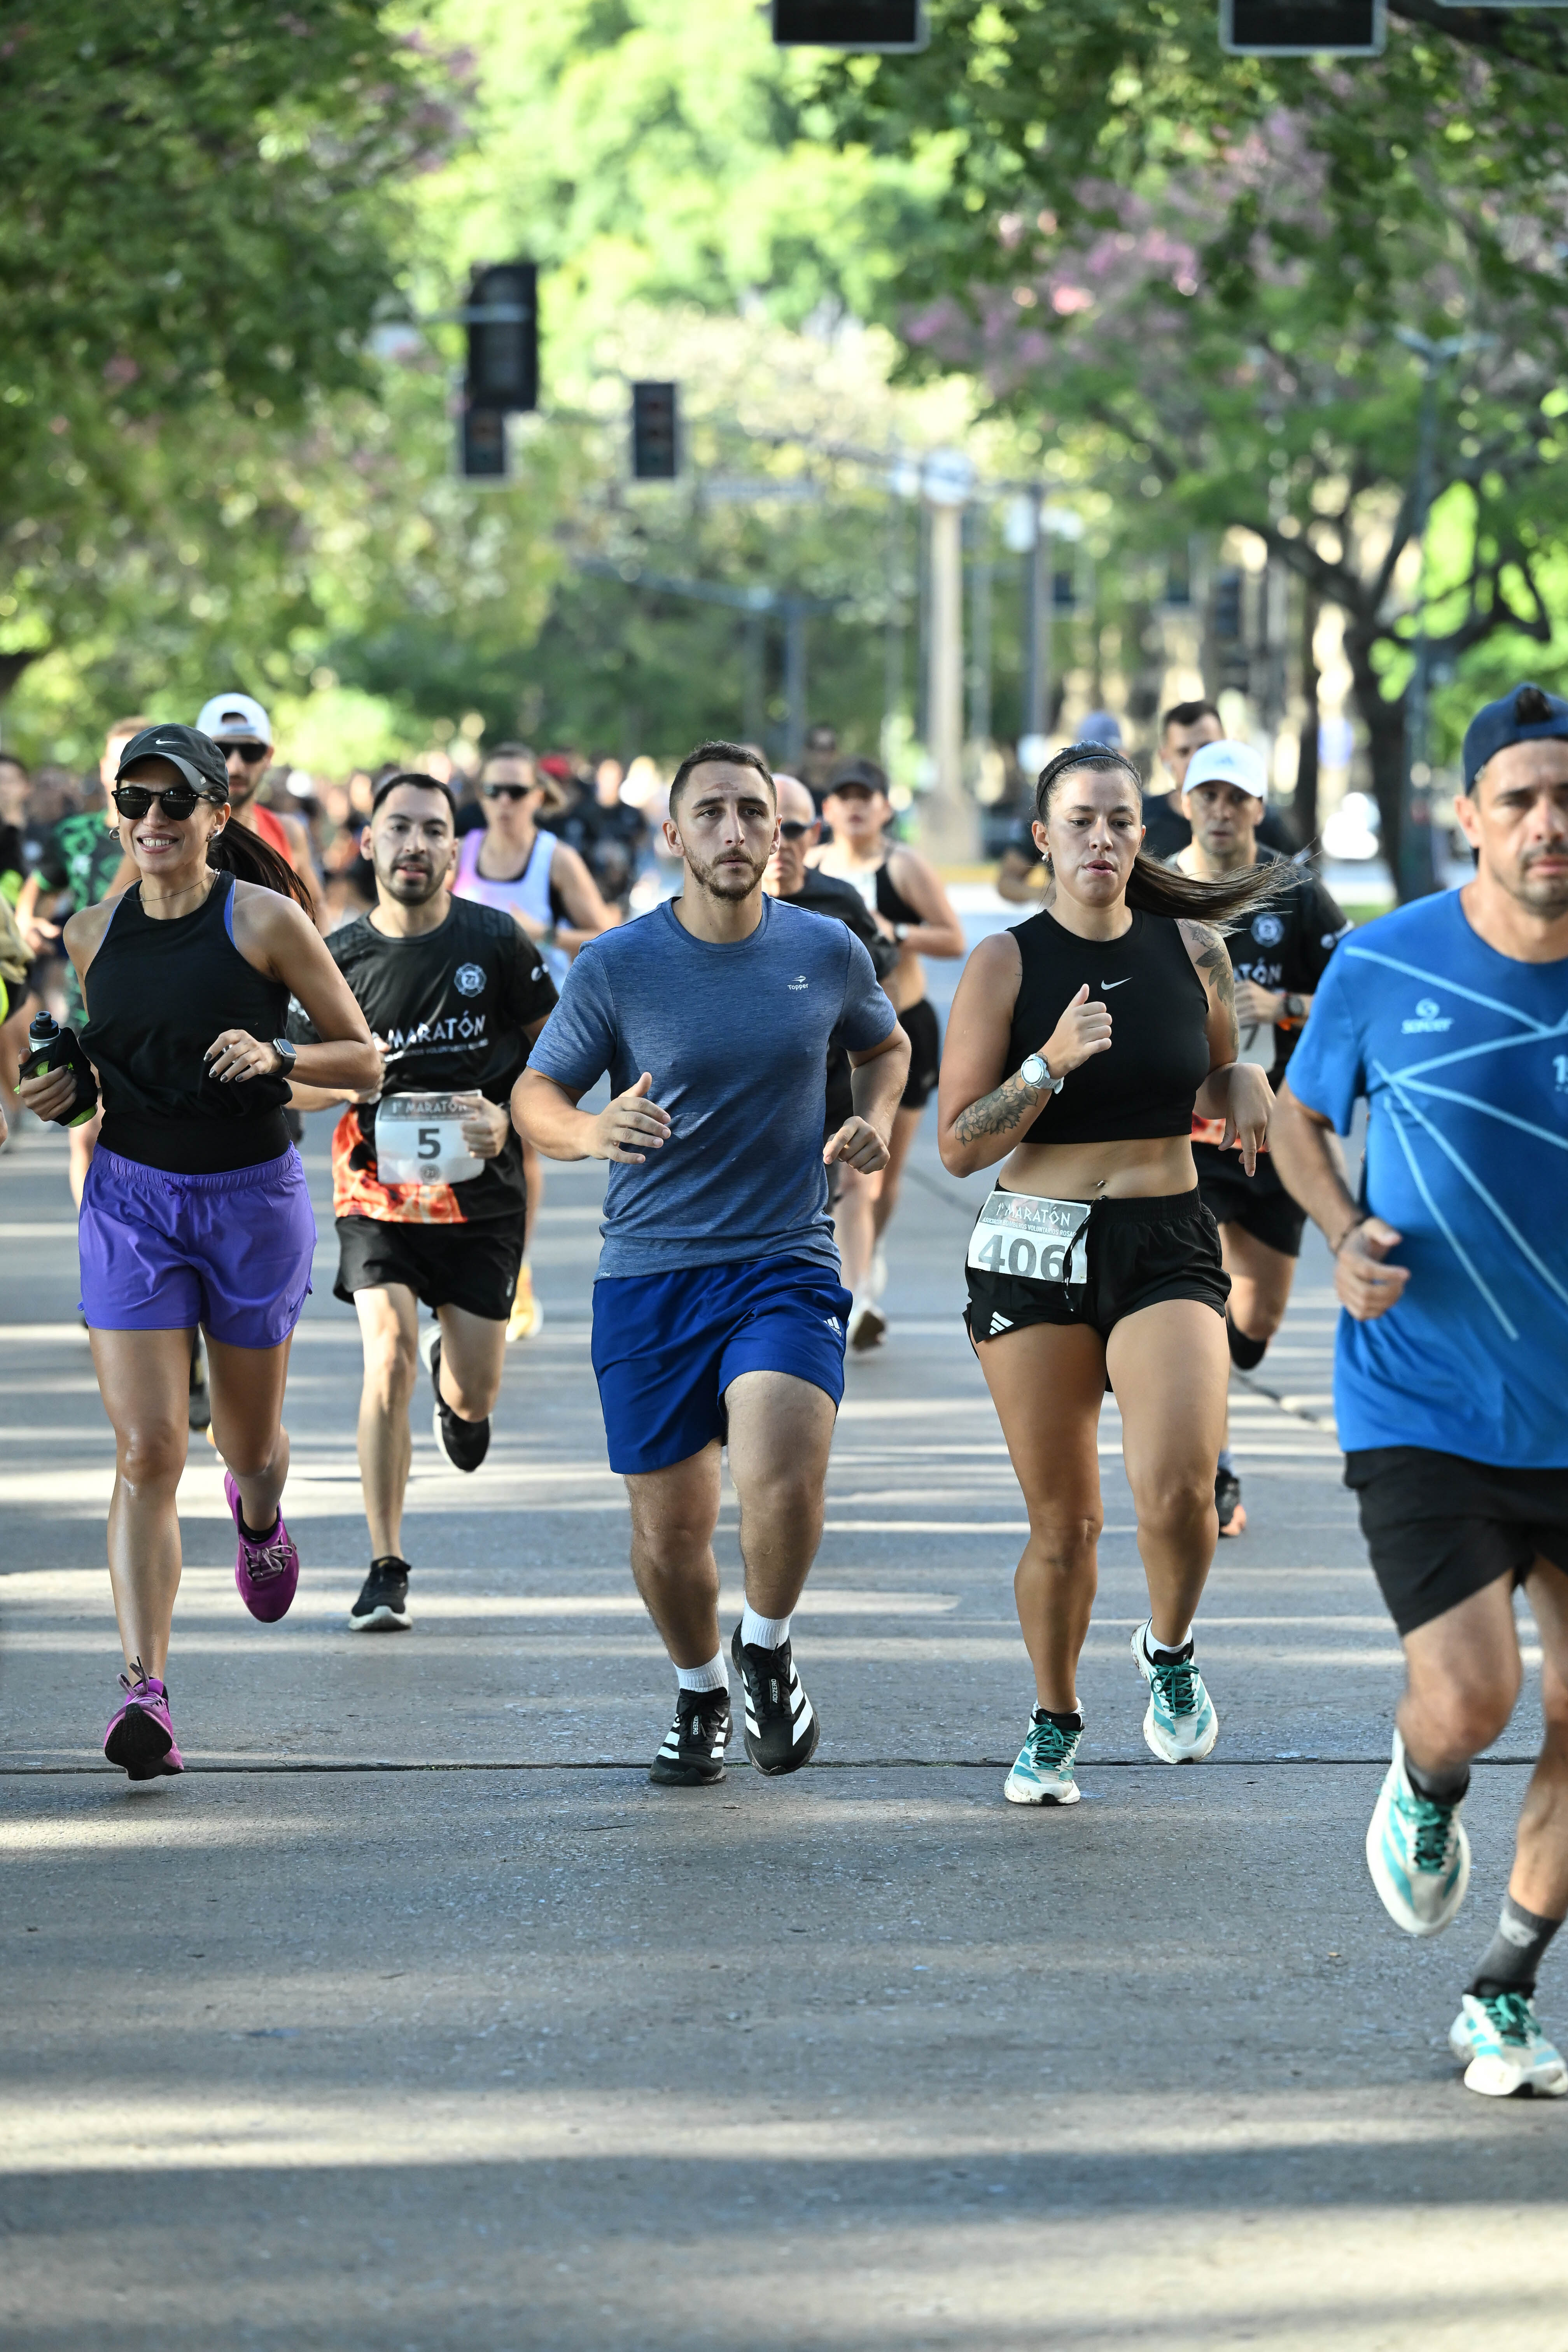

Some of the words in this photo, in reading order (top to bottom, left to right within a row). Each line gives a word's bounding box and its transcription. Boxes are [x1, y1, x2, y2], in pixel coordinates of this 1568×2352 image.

[388, 1010, 486, 1049] MARATÓN
[1552, 1055, 1568, 1084] 1
[417, 1128, 441, 1159] 5
[1003, 1220, 1027, 1229] BOMBEROS
[1027, 1225, 1059, 1235] VOLUNTARIOS
[1004, 1204, 1071, 1227] MARATÓN
[978, 1234, 1066, 1283] 406
